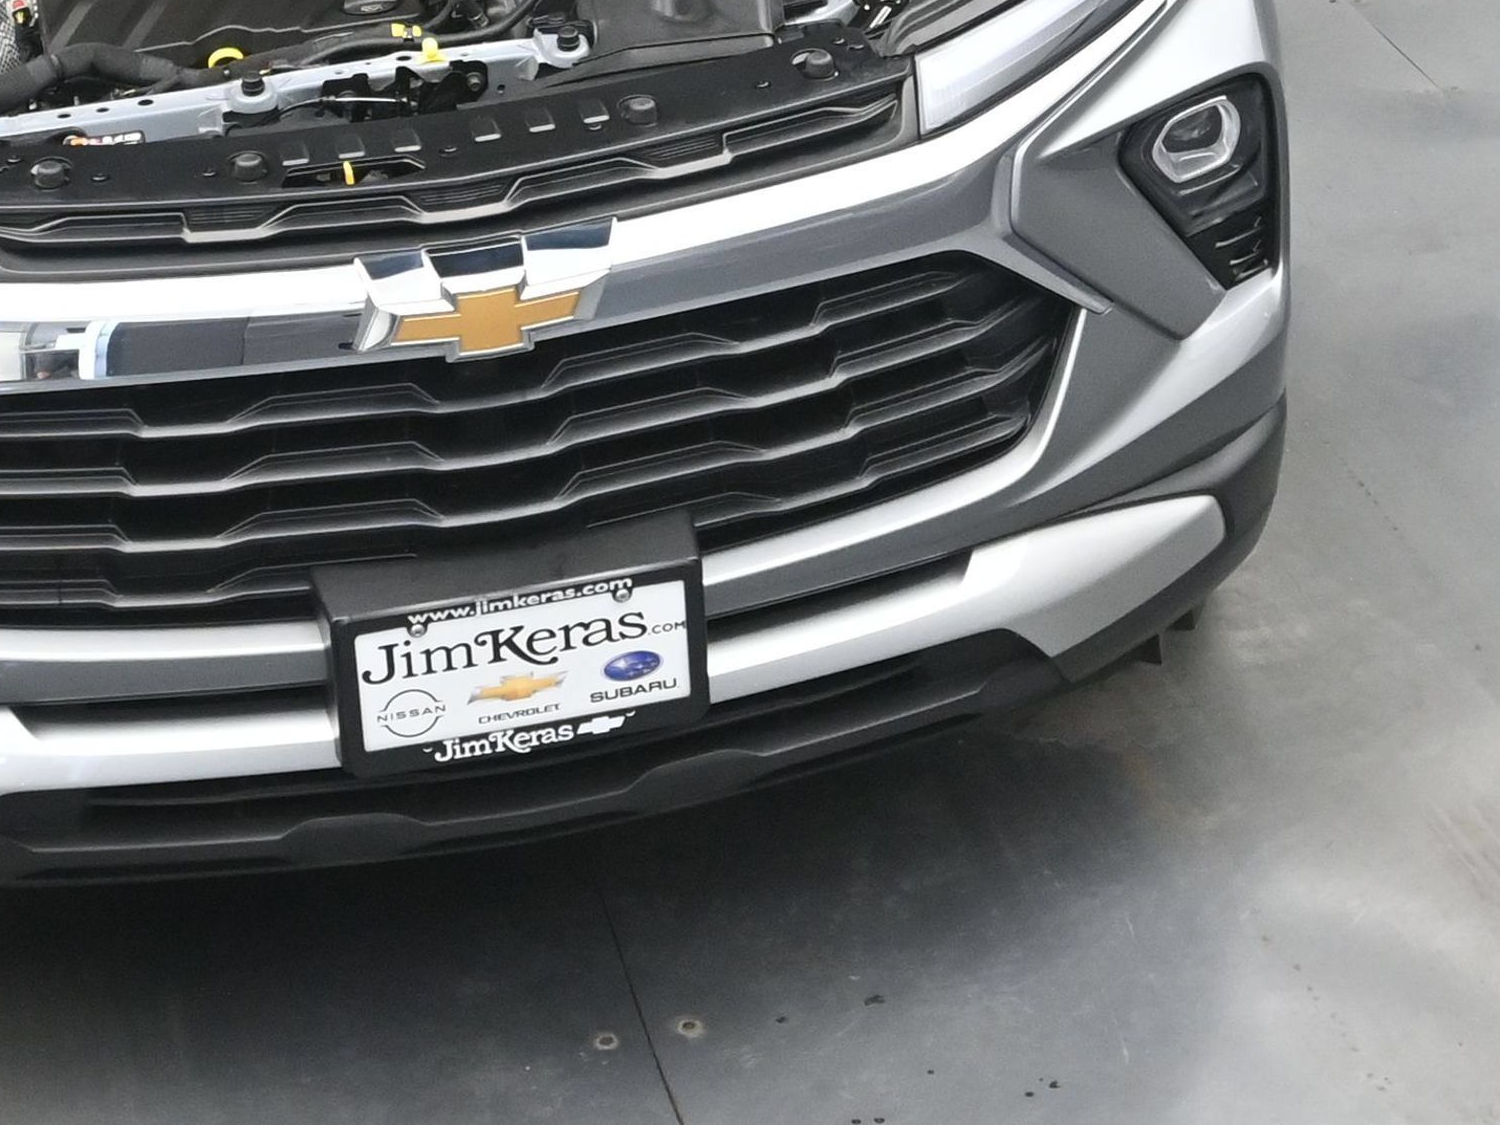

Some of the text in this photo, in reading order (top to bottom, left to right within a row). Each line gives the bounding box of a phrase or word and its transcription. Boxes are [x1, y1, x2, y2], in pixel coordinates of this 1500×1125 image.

[407, 577, 632, 624] www.jimkeras.com
[590, 678, 677, 703] SUBARU
[377, 704, 447, 724] NISSAN
[478, 703, 560, 724] CHEVROLET
